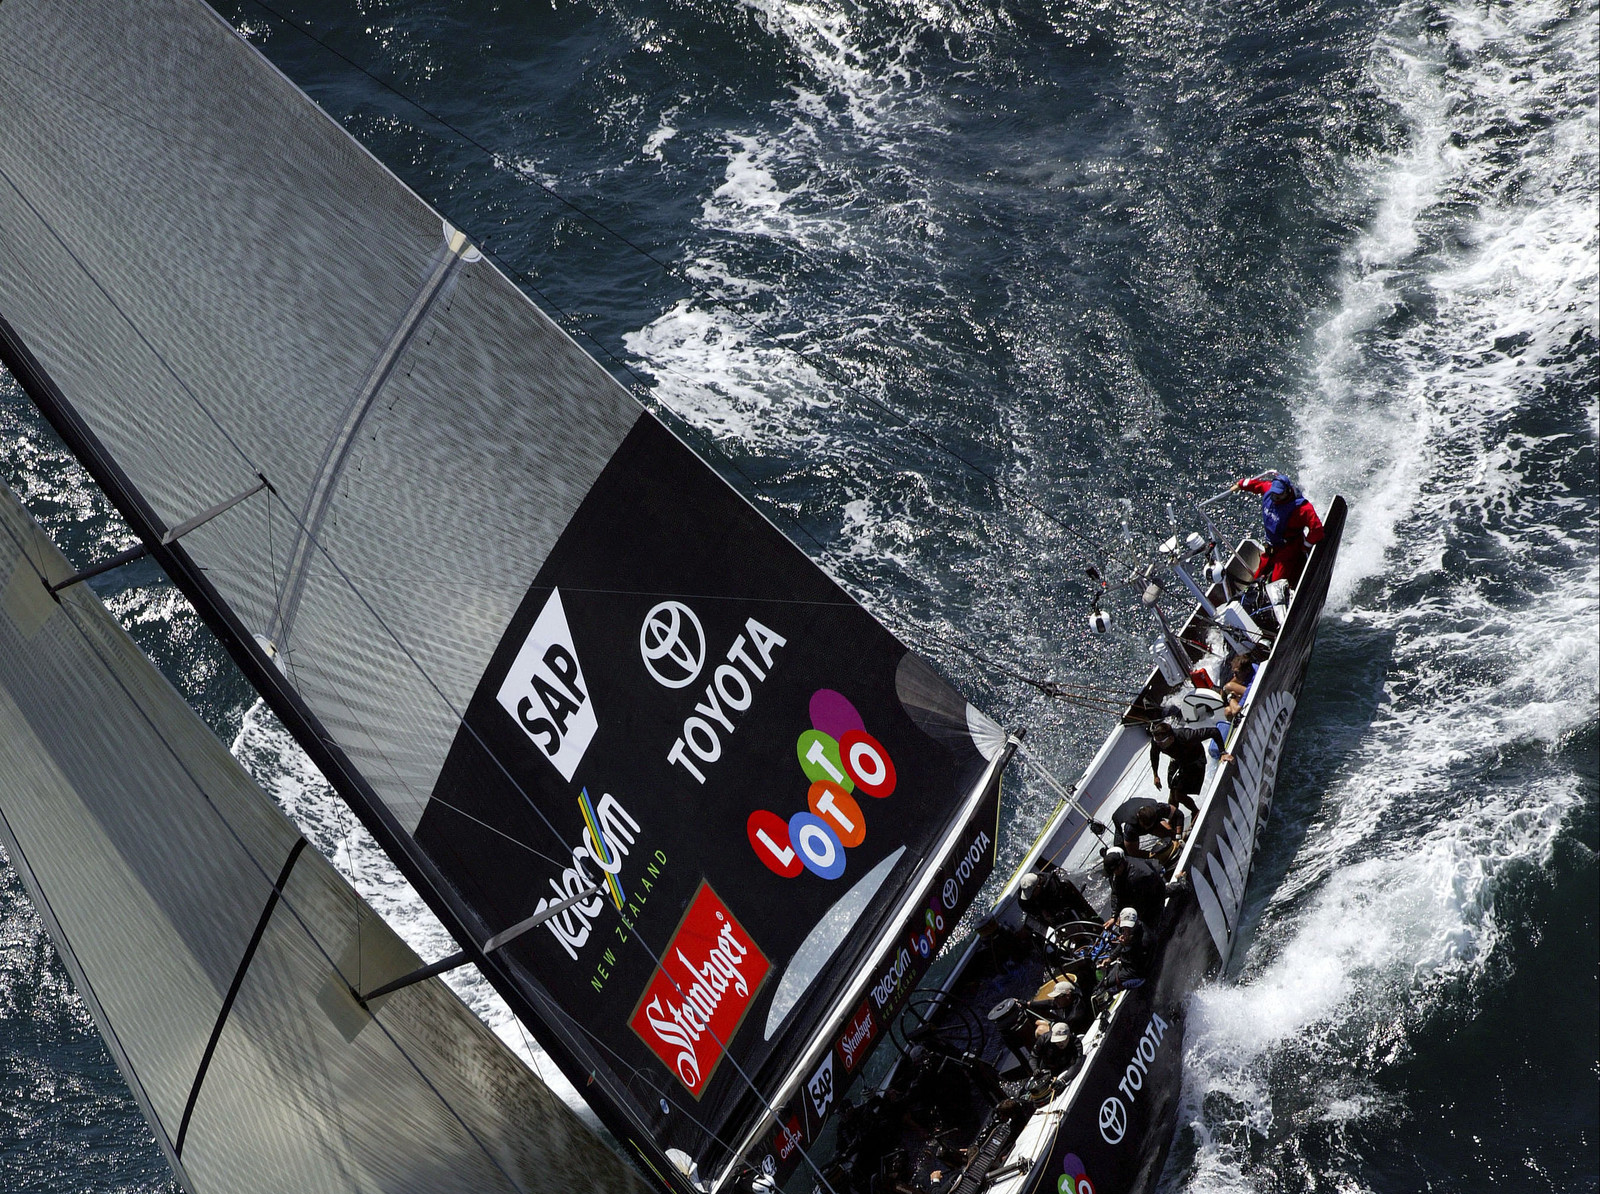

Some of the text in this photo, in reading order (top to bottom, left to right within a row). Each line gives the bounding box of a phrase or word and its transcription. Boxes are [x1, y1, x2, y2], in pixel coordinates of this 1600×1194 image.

[517, 643, 586, 757] SAP
[666, 617, 788, 785] TOYOTA
[755, 739, 887, 868] LOTTO
[955, 830, 991, 886] TOYOTA
[591, 849, 668, 993] NEW ZEALAND
[911, 912, 944, 955] LOTTO
[870, 948, 912, 1010] Telecom
[811, 1067, 833, 1110] SAP
[1118, 1011, 1169, 1103] TOYOTA
[780, 1130, 803, 1160] OMEGA
